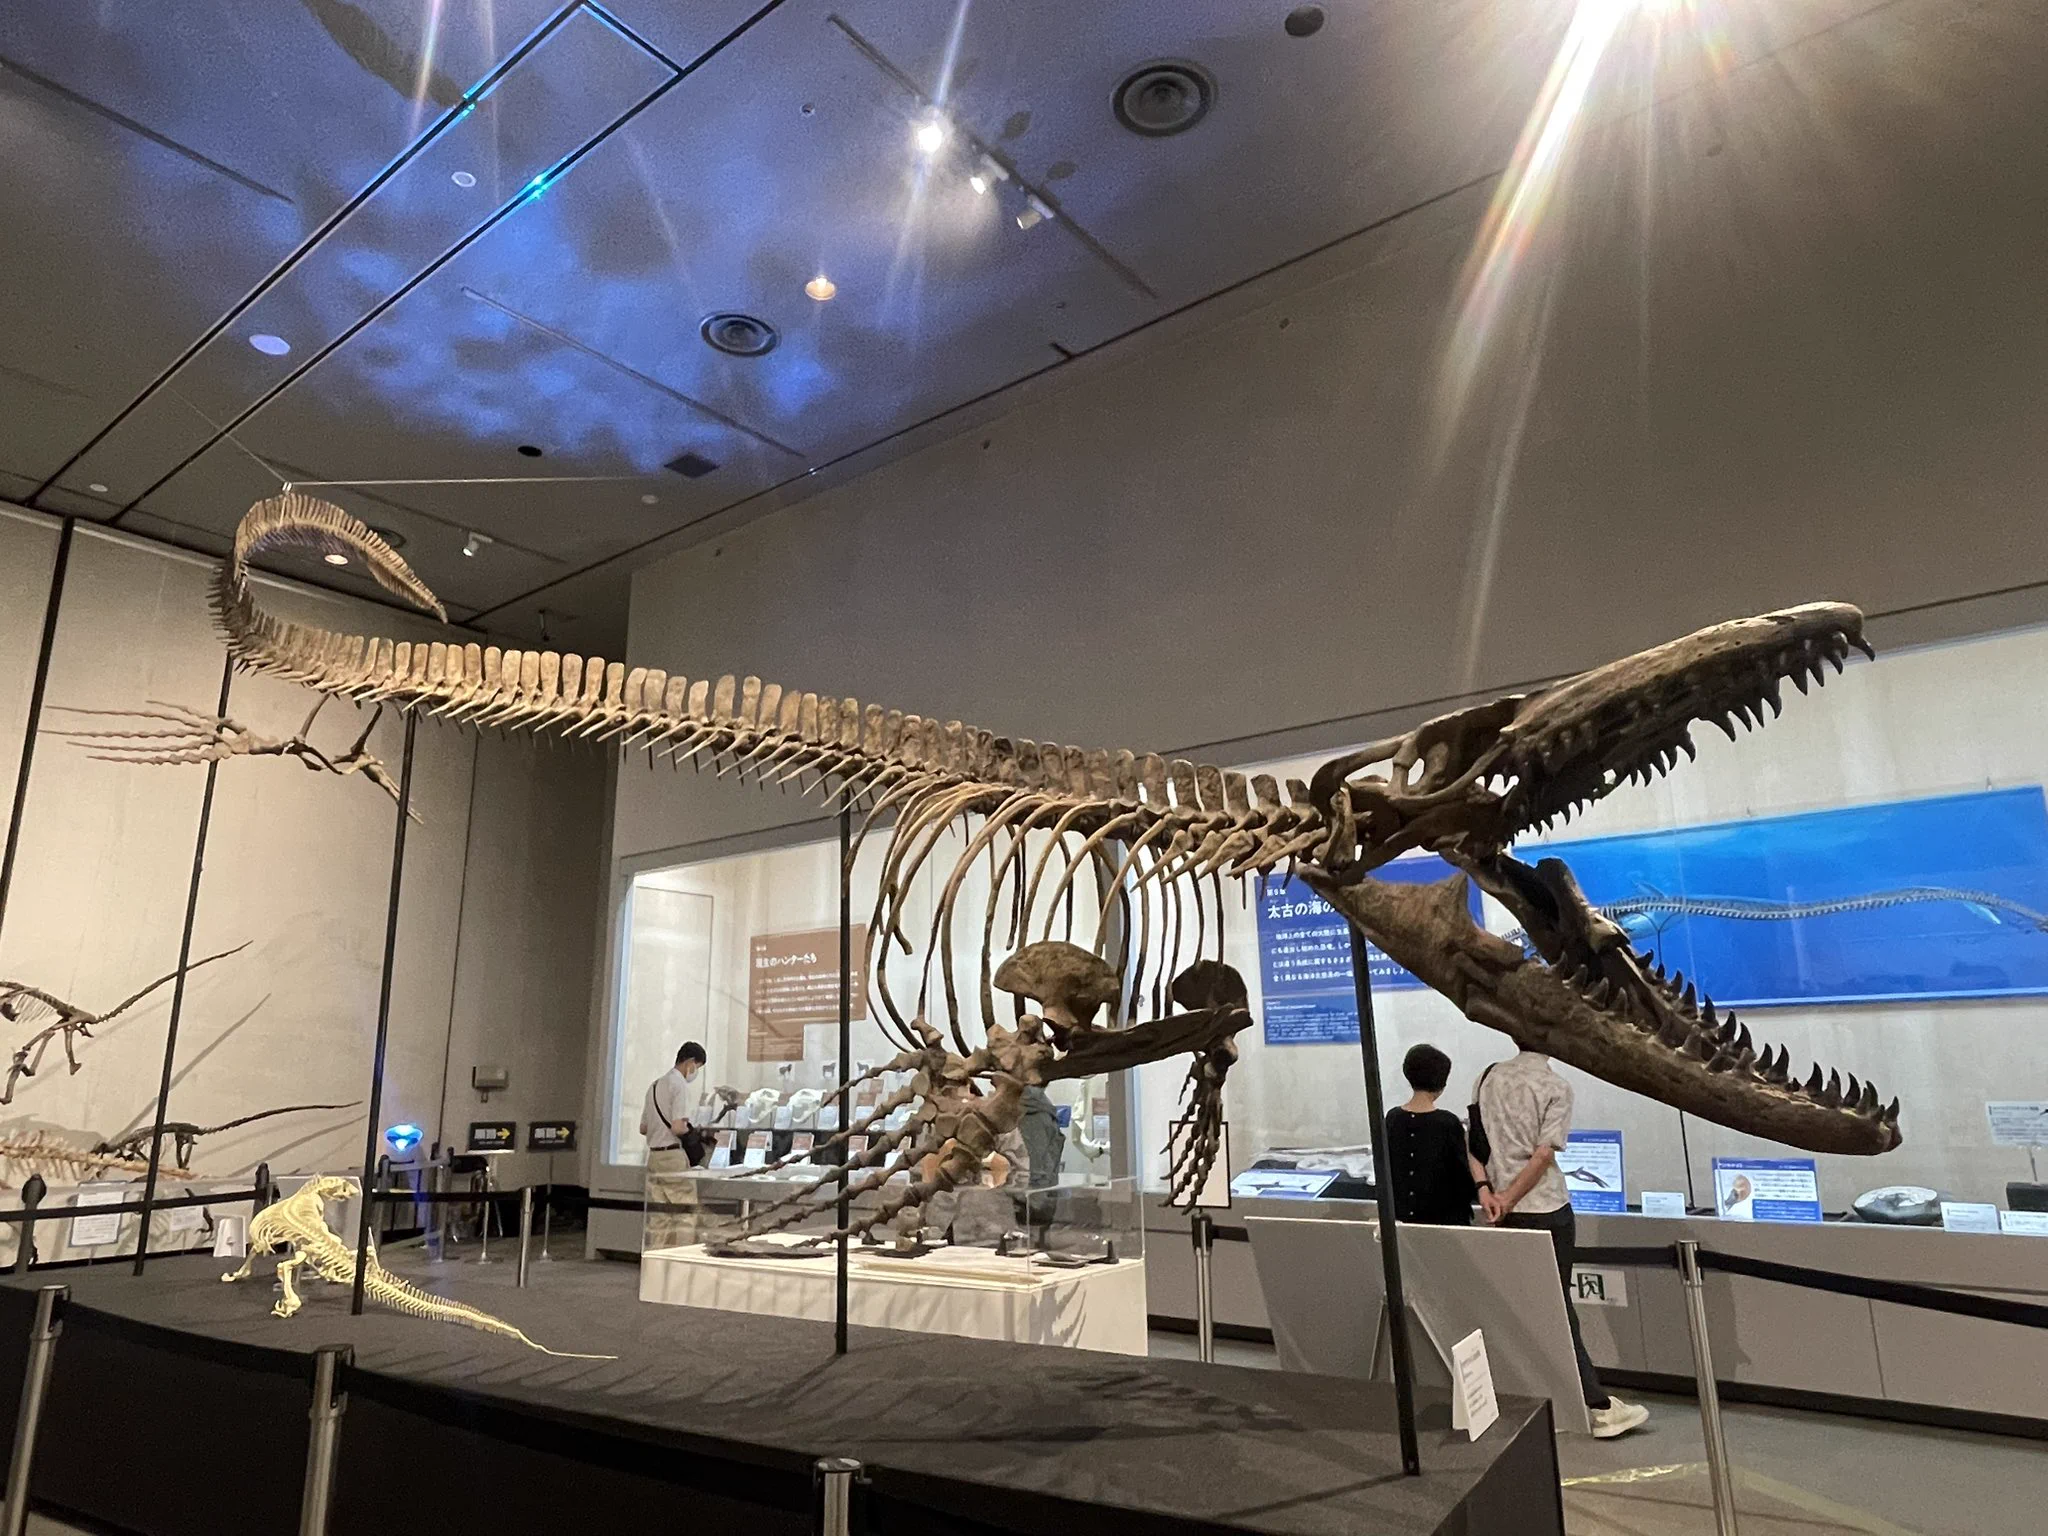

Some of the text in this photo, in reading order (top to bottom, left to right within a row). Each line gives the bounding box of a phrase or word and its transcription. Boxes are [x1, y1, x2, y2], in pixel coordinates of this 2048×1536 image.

[1267, 900, 1336, 919] 太古の海の
